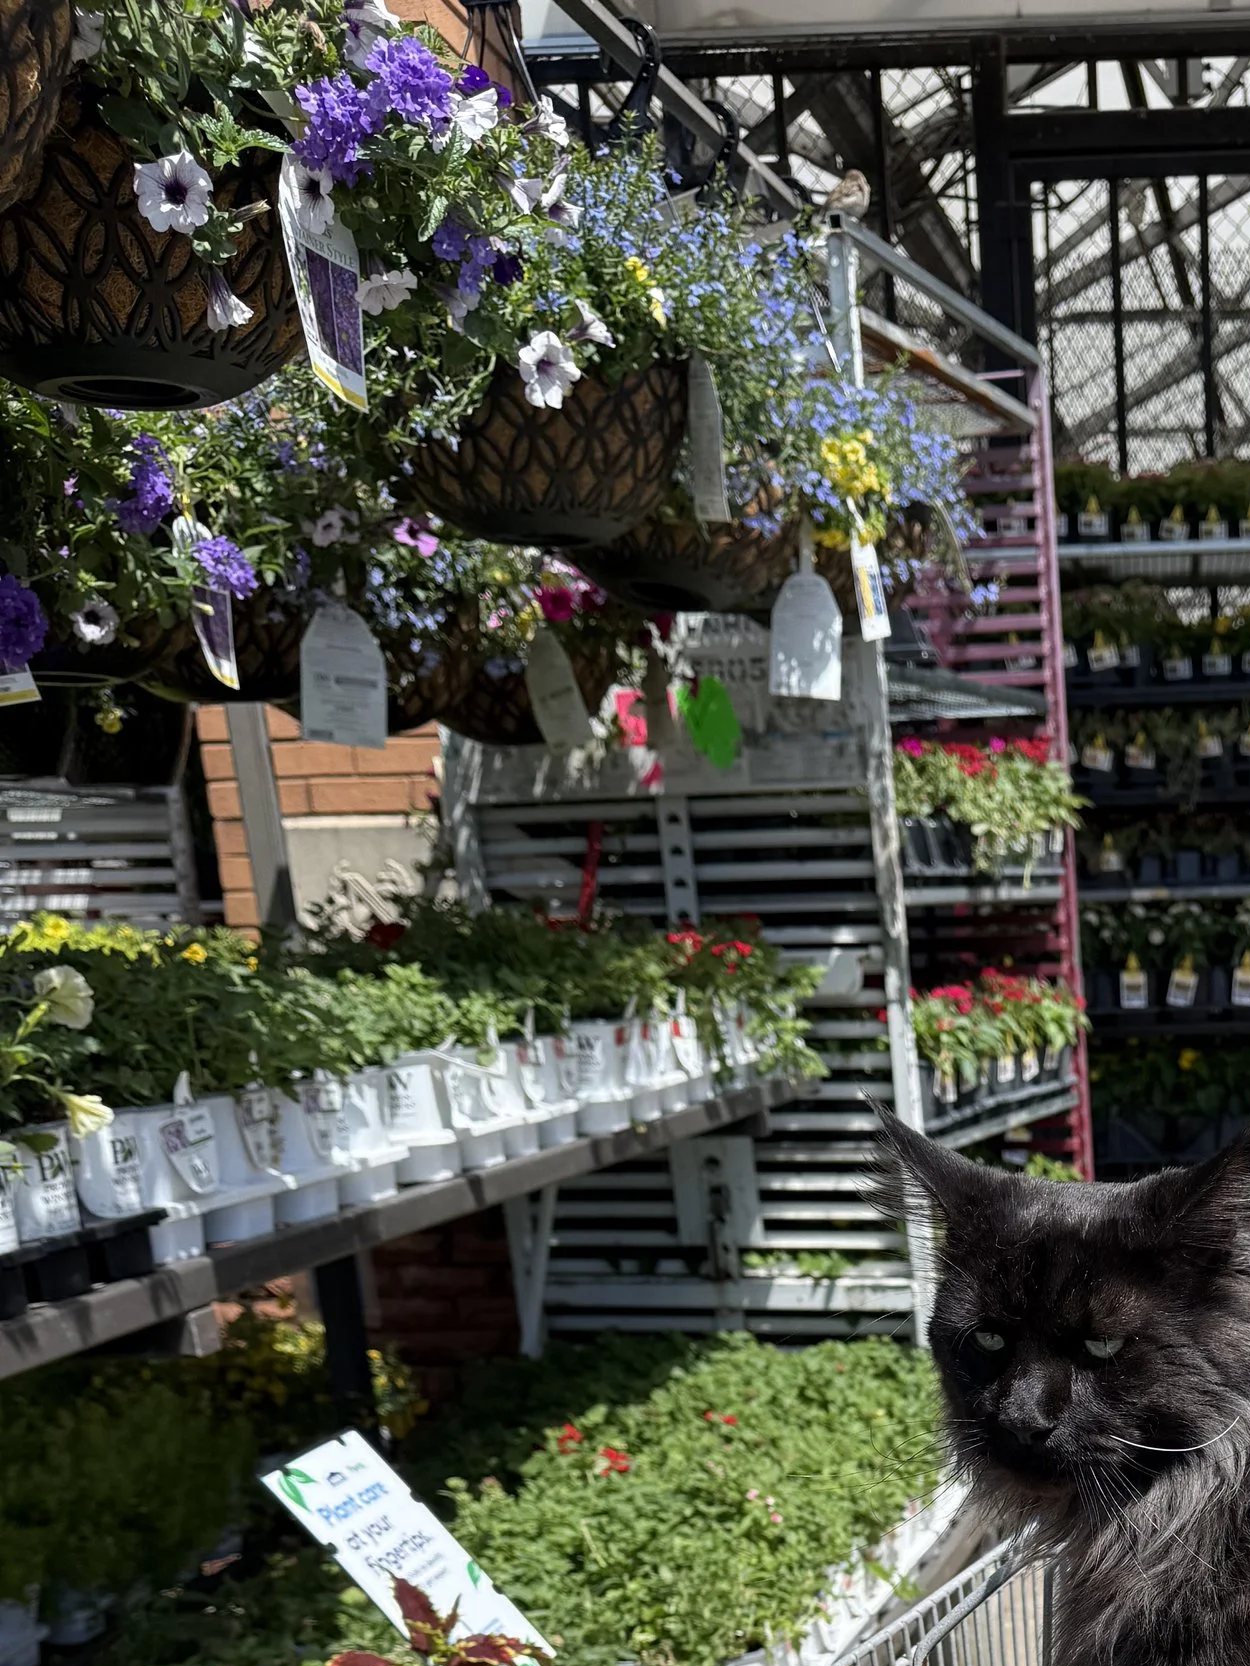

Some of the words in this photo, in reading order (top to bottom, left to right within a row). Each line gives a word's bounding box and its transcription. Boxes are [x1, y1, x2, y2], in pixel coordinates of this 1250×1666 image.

[316, 1494, 364, 1527] Plant
[357, 1482, 390, 1506] care
[345, 1531, 368, 1551] at
[361, 1514, 396, 1547] your
